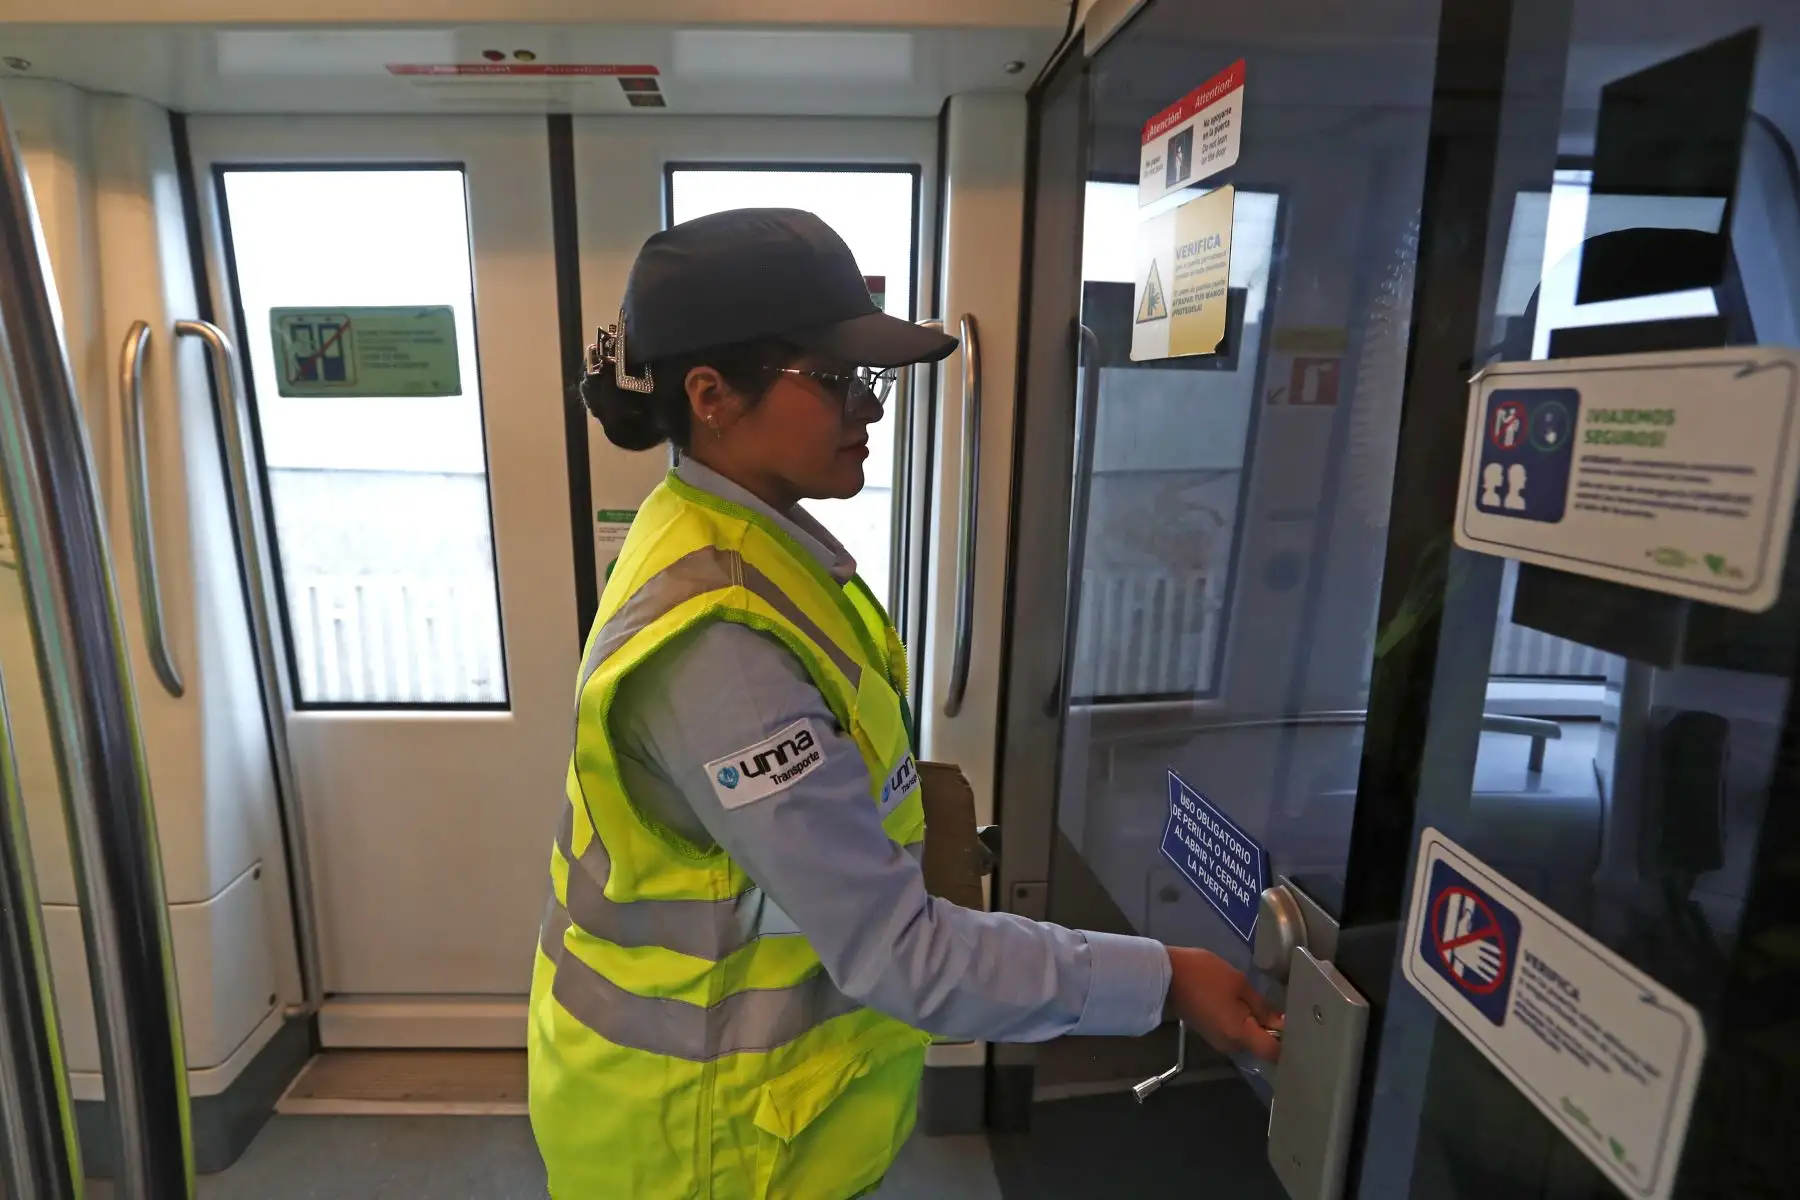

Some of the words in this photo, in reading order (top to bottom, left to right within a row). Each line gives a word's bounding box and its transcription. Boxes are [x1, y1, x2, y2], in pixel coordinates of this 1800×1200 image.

[1146, 106, 1183, 141] ¡Atención!
[1194, 74, 1235, 110] Attention!
[1175, 233, 1222, 260] VERIFICA
[739, 729, 815, 779] unna
[769, 750, 821, 786] Transporte
[1172, 804, 1182, 821] DE
[1182, 814, 1213, 850] PERILLA
[1214, 843, 1221, 856] O
[1222, 850, 1257, 894] MANIJA
[1180, 793, 1195, 814] USO
[1196, 807, 1251, 865] OBLIGATORIO
[1174, 824, 1184, 841] AL
[1184, 835, 1208, 865] ABRIR
[1209, 856, 1215, 869] Y
[1215, 866, 1250, 907] CERRAR
[1187, 855, 1197, 873] LA
[1198, 869, 1229, 907] PUERTA
